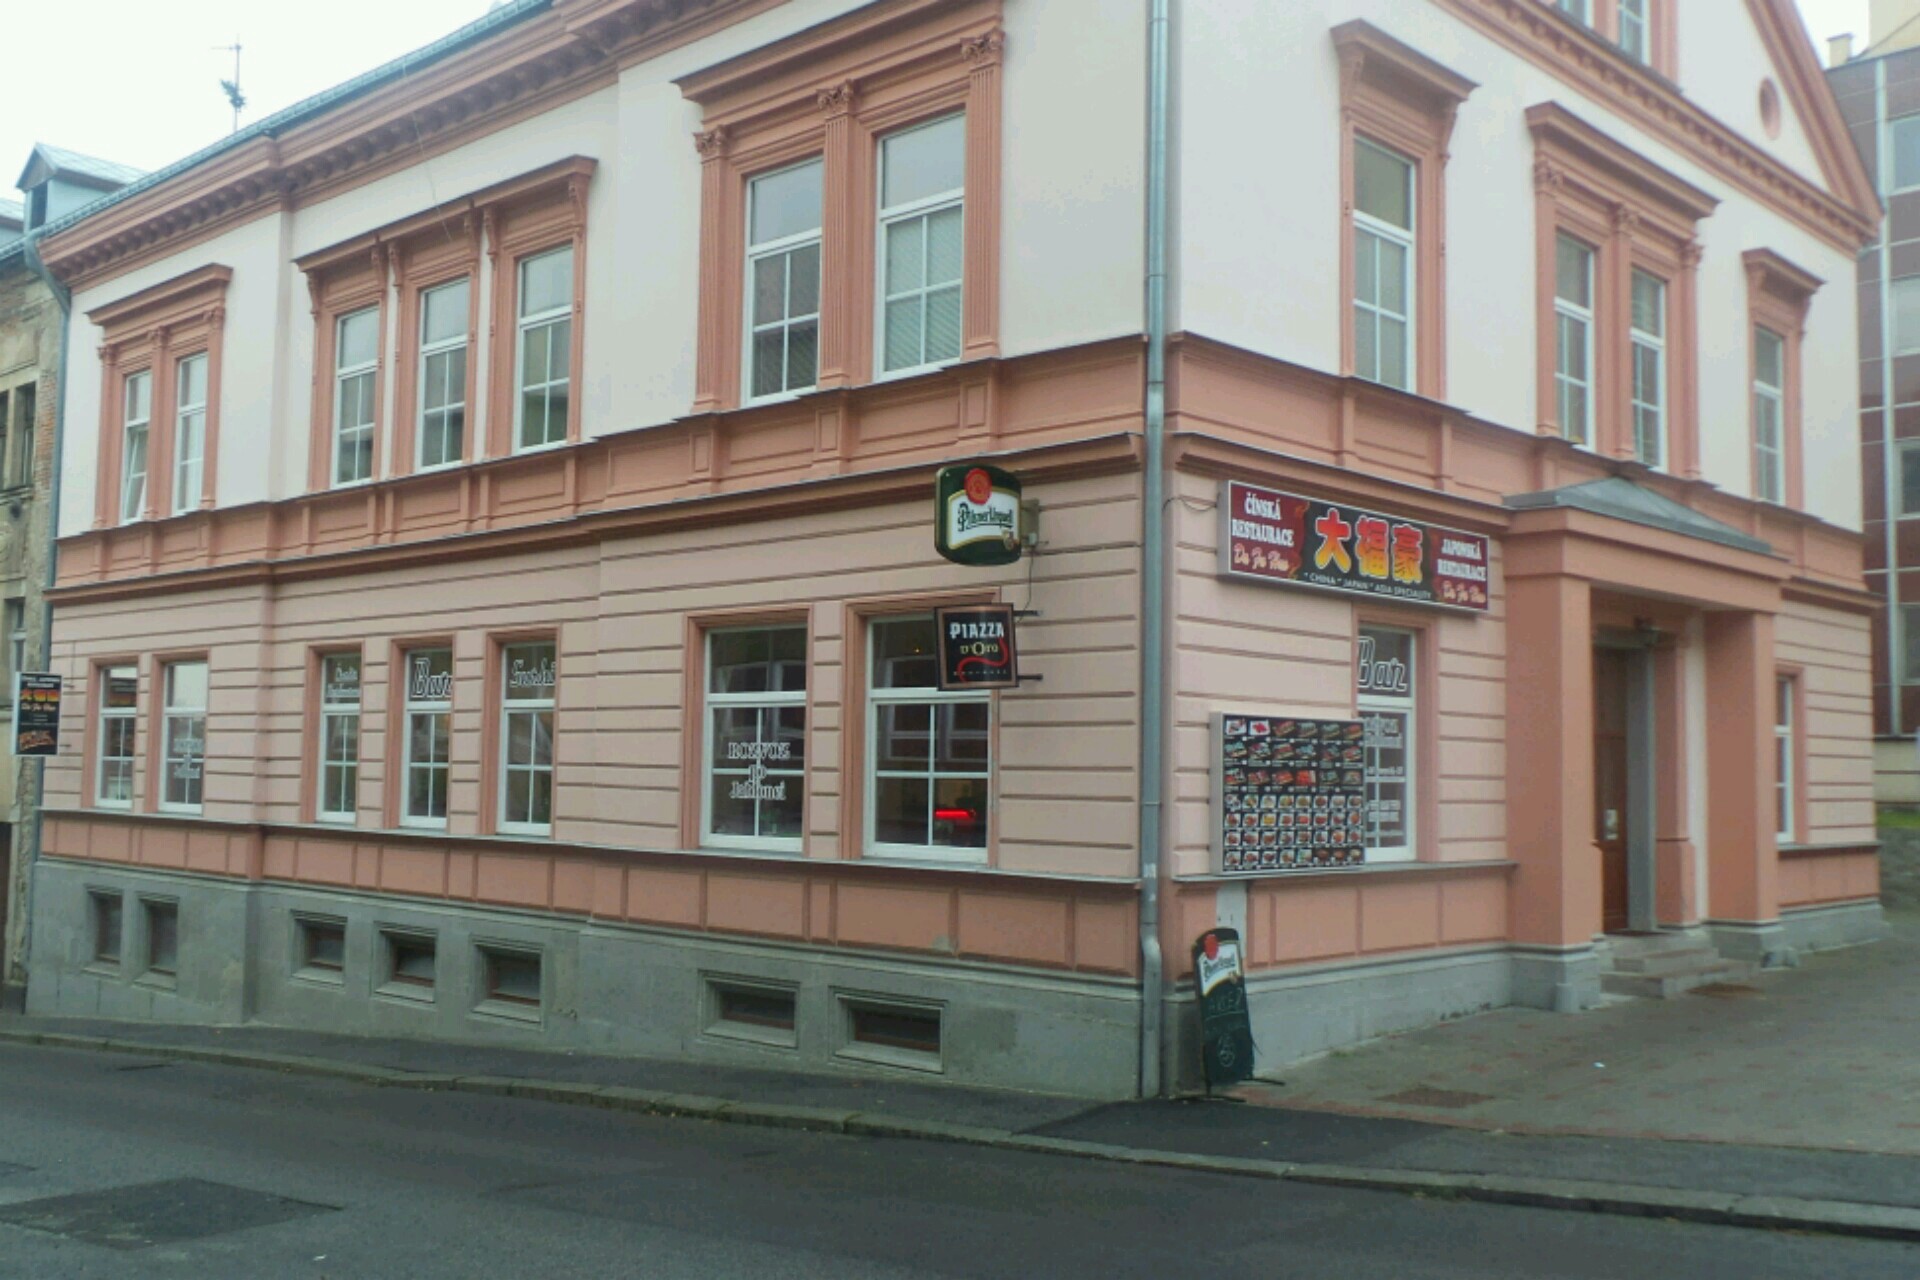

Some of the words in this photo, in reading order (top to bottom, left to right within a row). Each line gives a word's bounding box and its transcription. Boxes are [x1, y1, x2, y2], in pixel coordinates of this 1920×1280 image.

[957, 502, 989, 532] Pilsner
[1244, 491, 1282, 520] ČÍNSKÁ
[1232, 518, 1295, 548] RESTAURACE
[1309, 573, 1336, 585] CHINA
[949, 621, 1005, 639] PIAZZA
[1357, 636, 1408, 692] Bar
